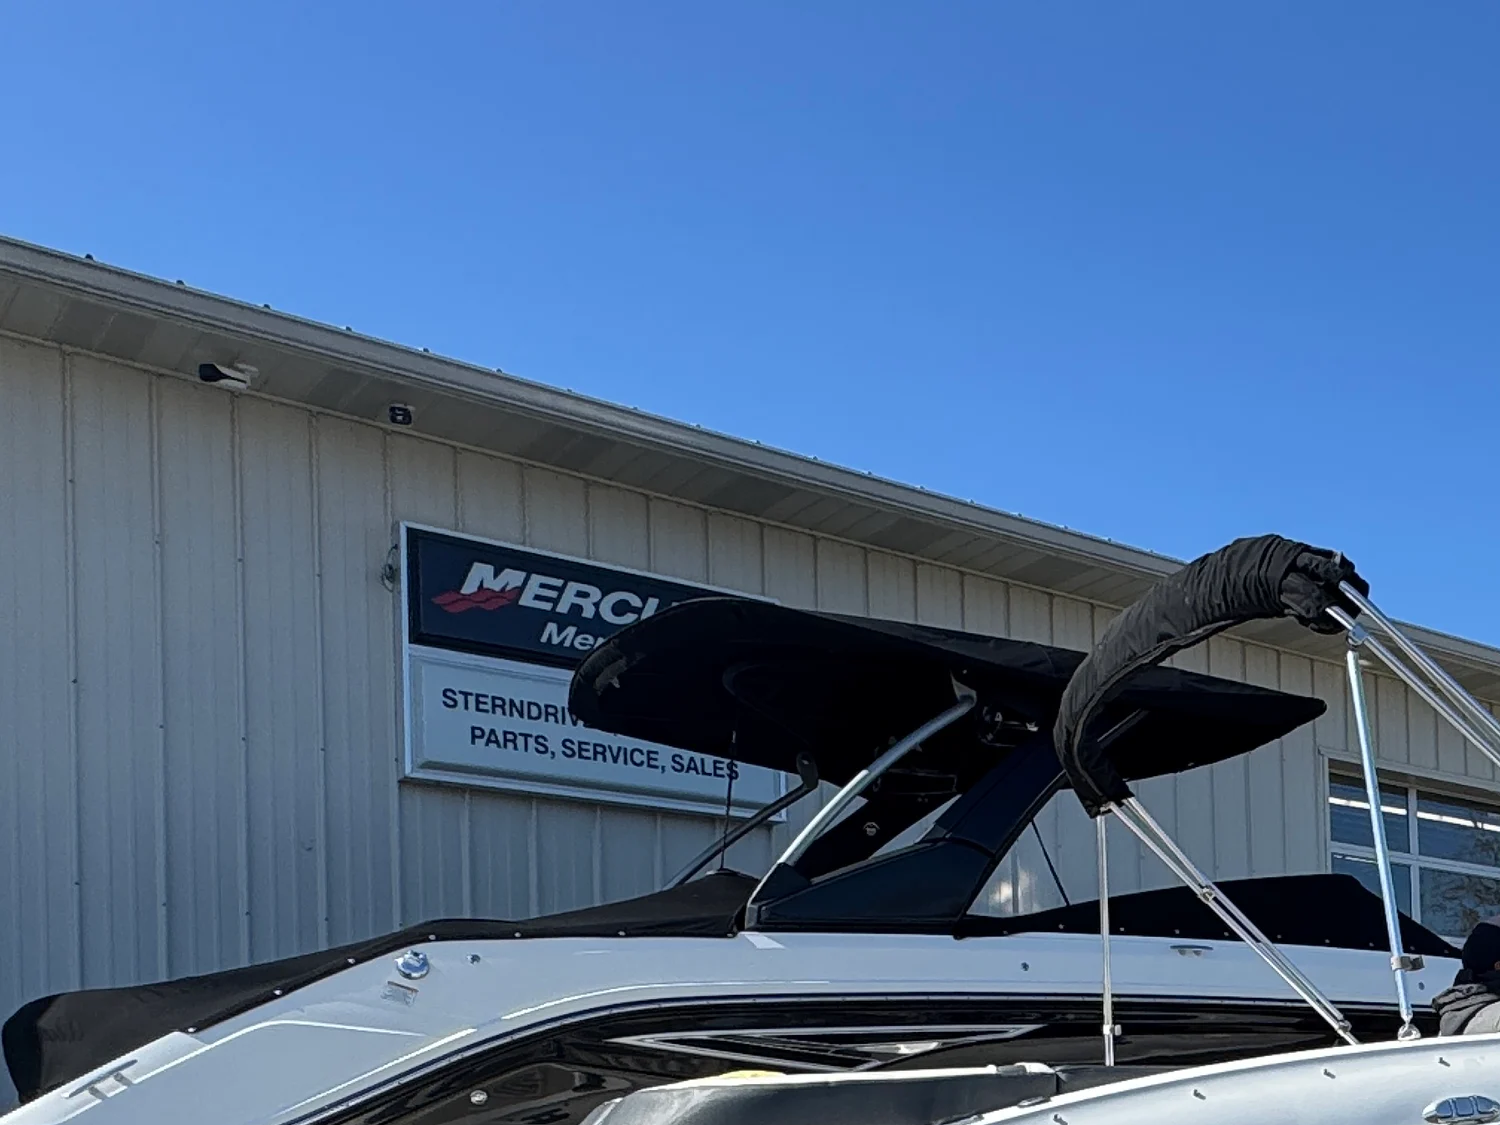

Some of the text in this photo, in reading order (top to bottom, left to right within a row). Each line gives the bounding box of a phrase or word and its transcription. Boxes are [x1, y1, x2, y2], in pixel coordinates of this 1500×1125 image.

[442, 688, 591, 728] STERNDRIV
[470, 725, 739, 780] PARTS, SERVICE, SALES
